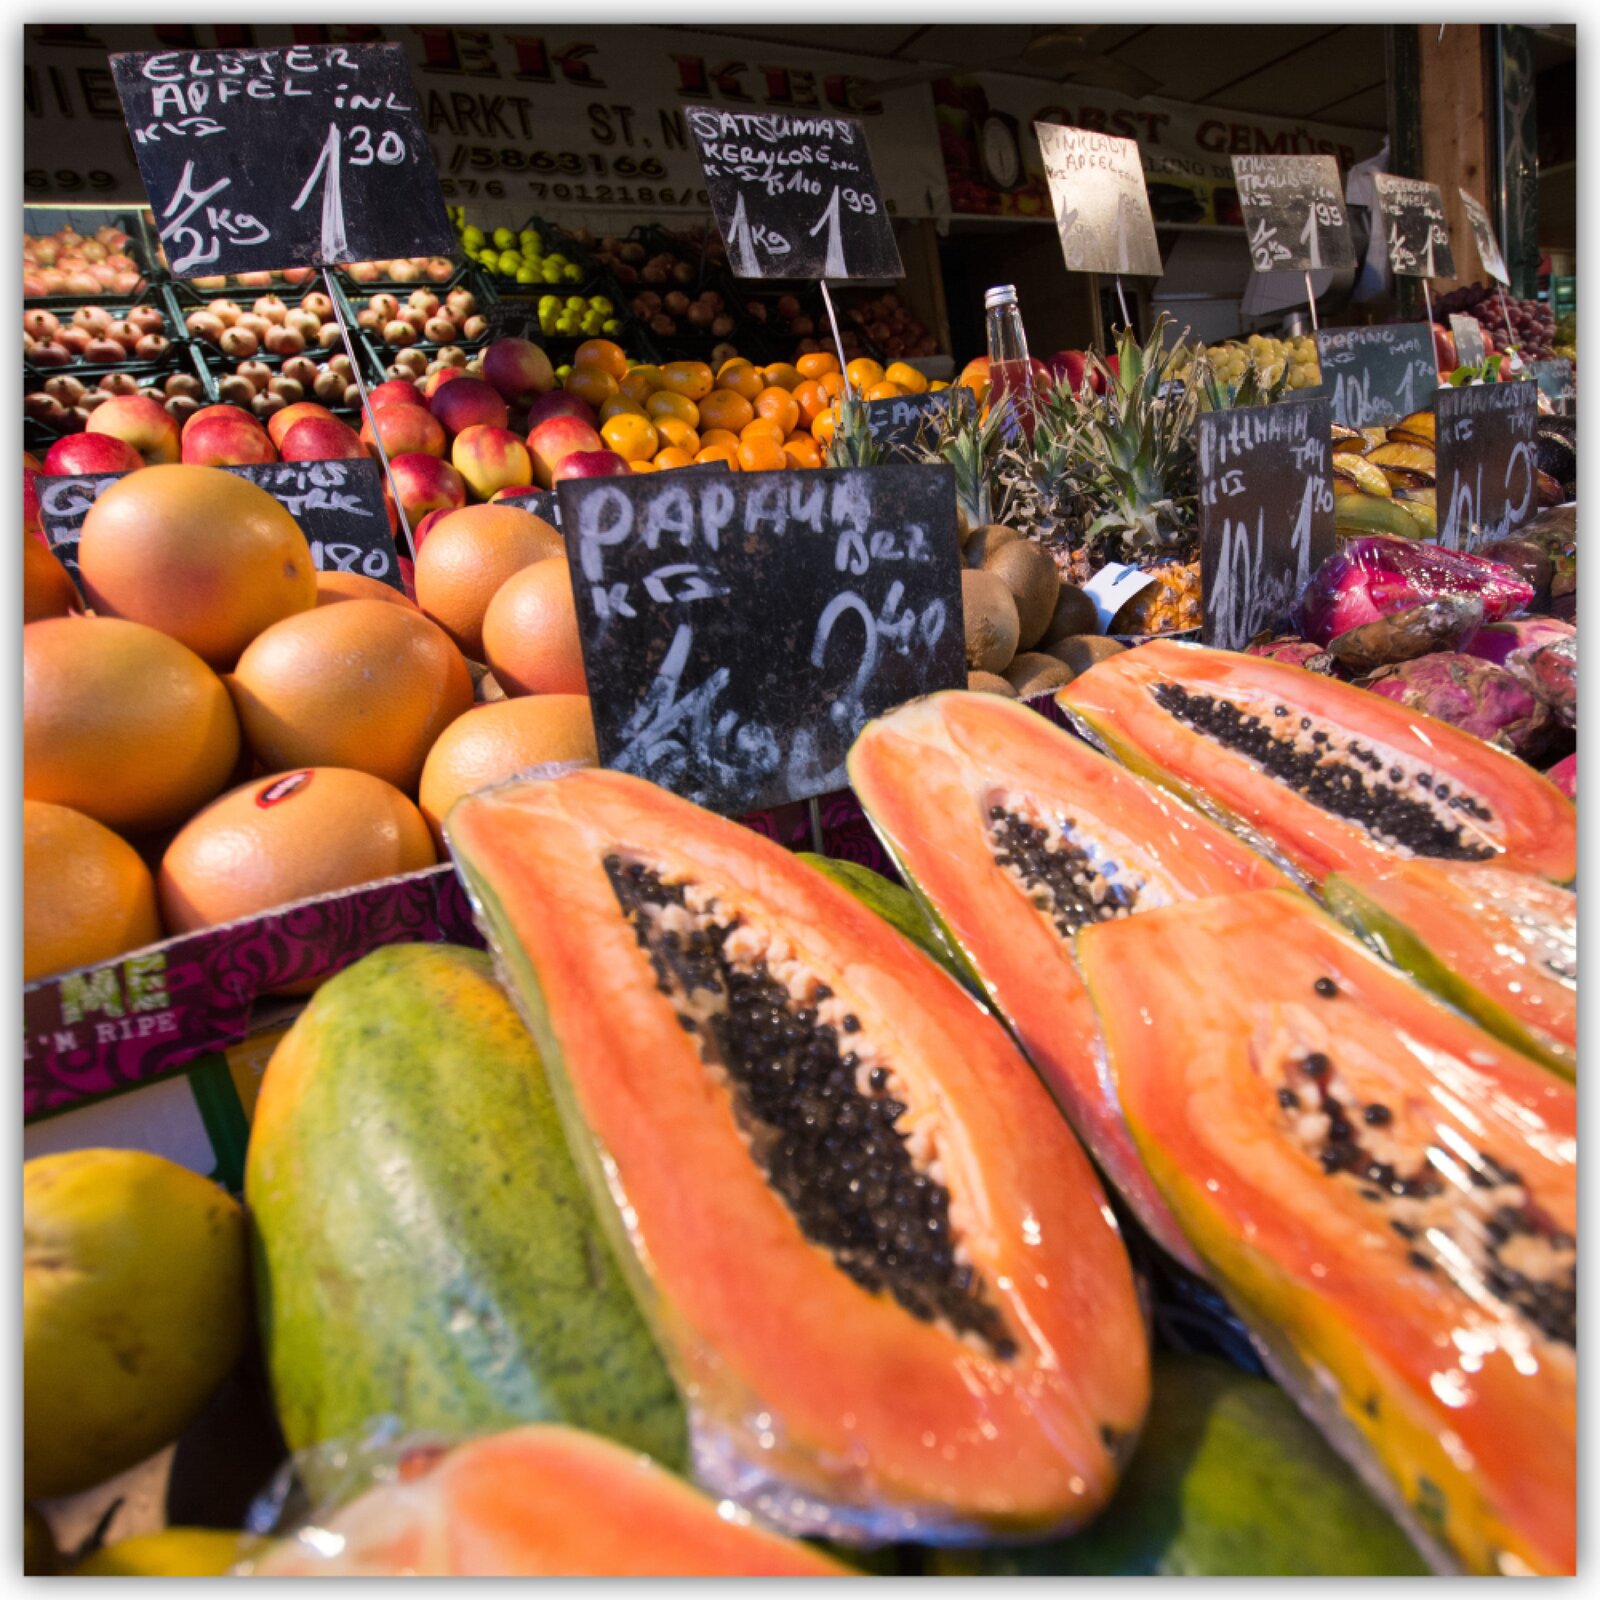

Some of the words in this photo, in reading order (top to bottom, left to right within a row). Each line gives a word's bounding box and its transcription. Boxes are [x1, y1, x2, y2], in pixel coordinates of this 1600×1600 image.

[141, 46, 359, 82] ELSTER
[428, 88, 533, 140] ARKT
[587, 101, 688, 152] ST.N
[691, 112, 854, 145] SATSUMAS
[703, 141, 832, 166] KERNLOSE
[95, 1011, 178, 1044] RIPE
